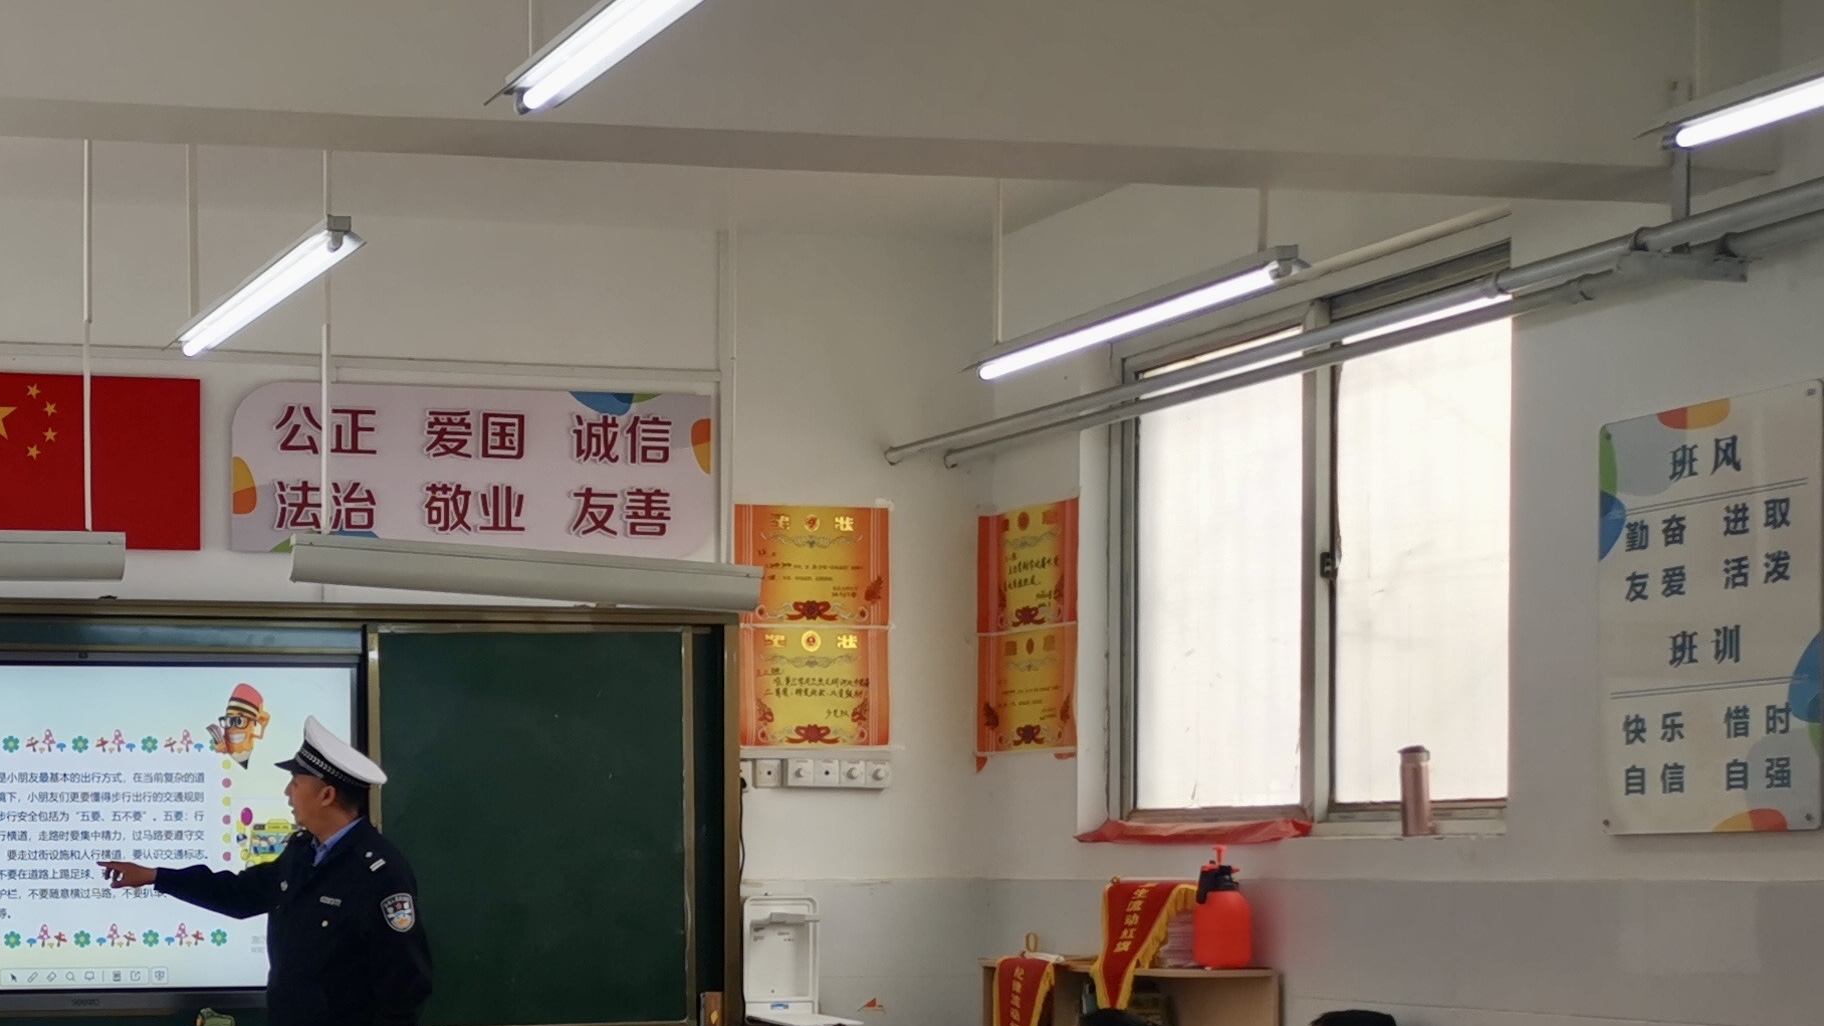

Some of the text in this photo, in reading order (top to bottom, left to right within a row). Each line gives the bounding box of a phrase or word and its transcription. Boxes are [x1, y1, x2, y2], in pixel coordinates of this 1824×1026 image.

[275, 406, 673, 464] 公正 爱国 诚信
[1668, 435, 1742, 481] 班风
[275, 481, 672, 537] 法治 敬业 友善
[1625, 497, 1791, 552] 勤奋 进取
[1625, 550, 1791, 602] 友爱 活泼
[1668, 625, 1742, 667] 班训
[1623, 701, 1792, 746] 快乐 惜时
[1624, 756, 1792, 797] 自信 自强
